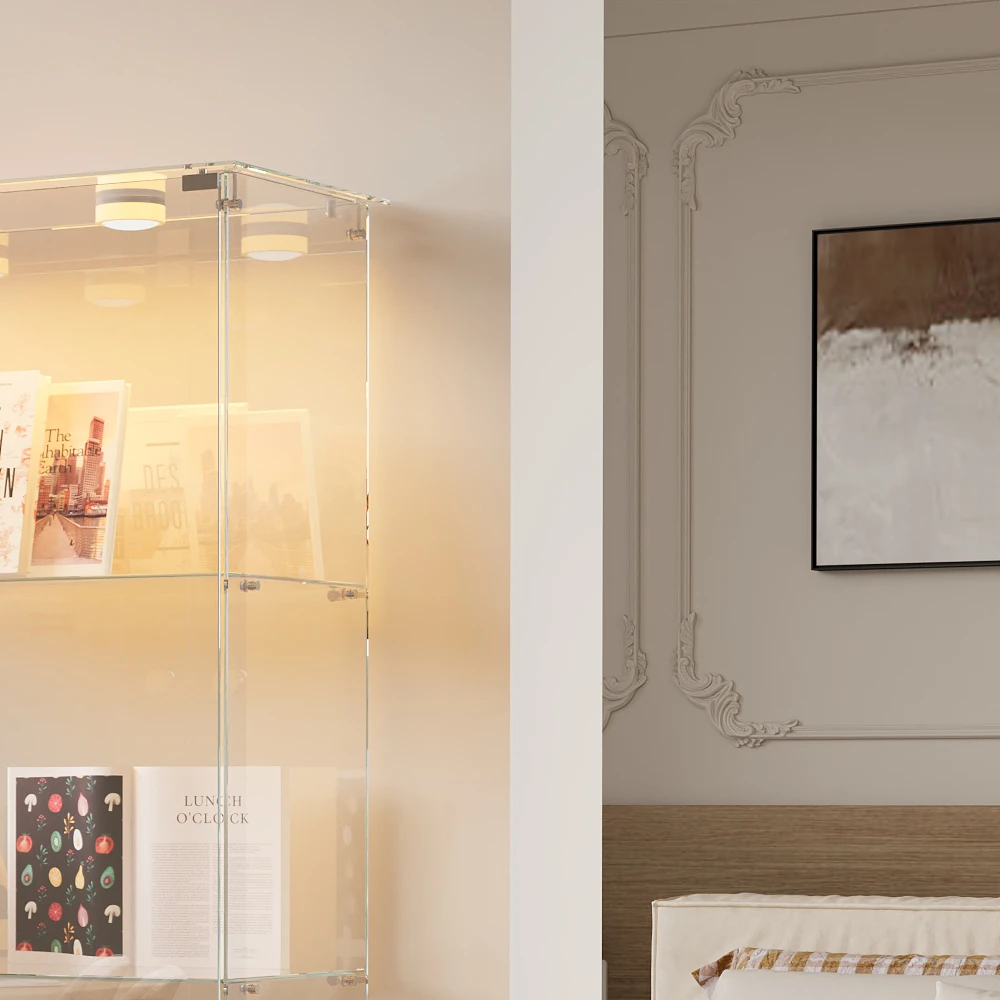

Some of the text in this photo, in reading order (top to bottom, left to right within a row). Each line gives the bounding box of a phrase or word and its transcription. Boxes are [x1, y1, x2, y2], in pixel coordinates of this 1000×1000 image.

[45, 428, 72, 443] The
[184, 795, 242, 807] LUNCH
[176, 812, 249, 825] O'CLOCK
